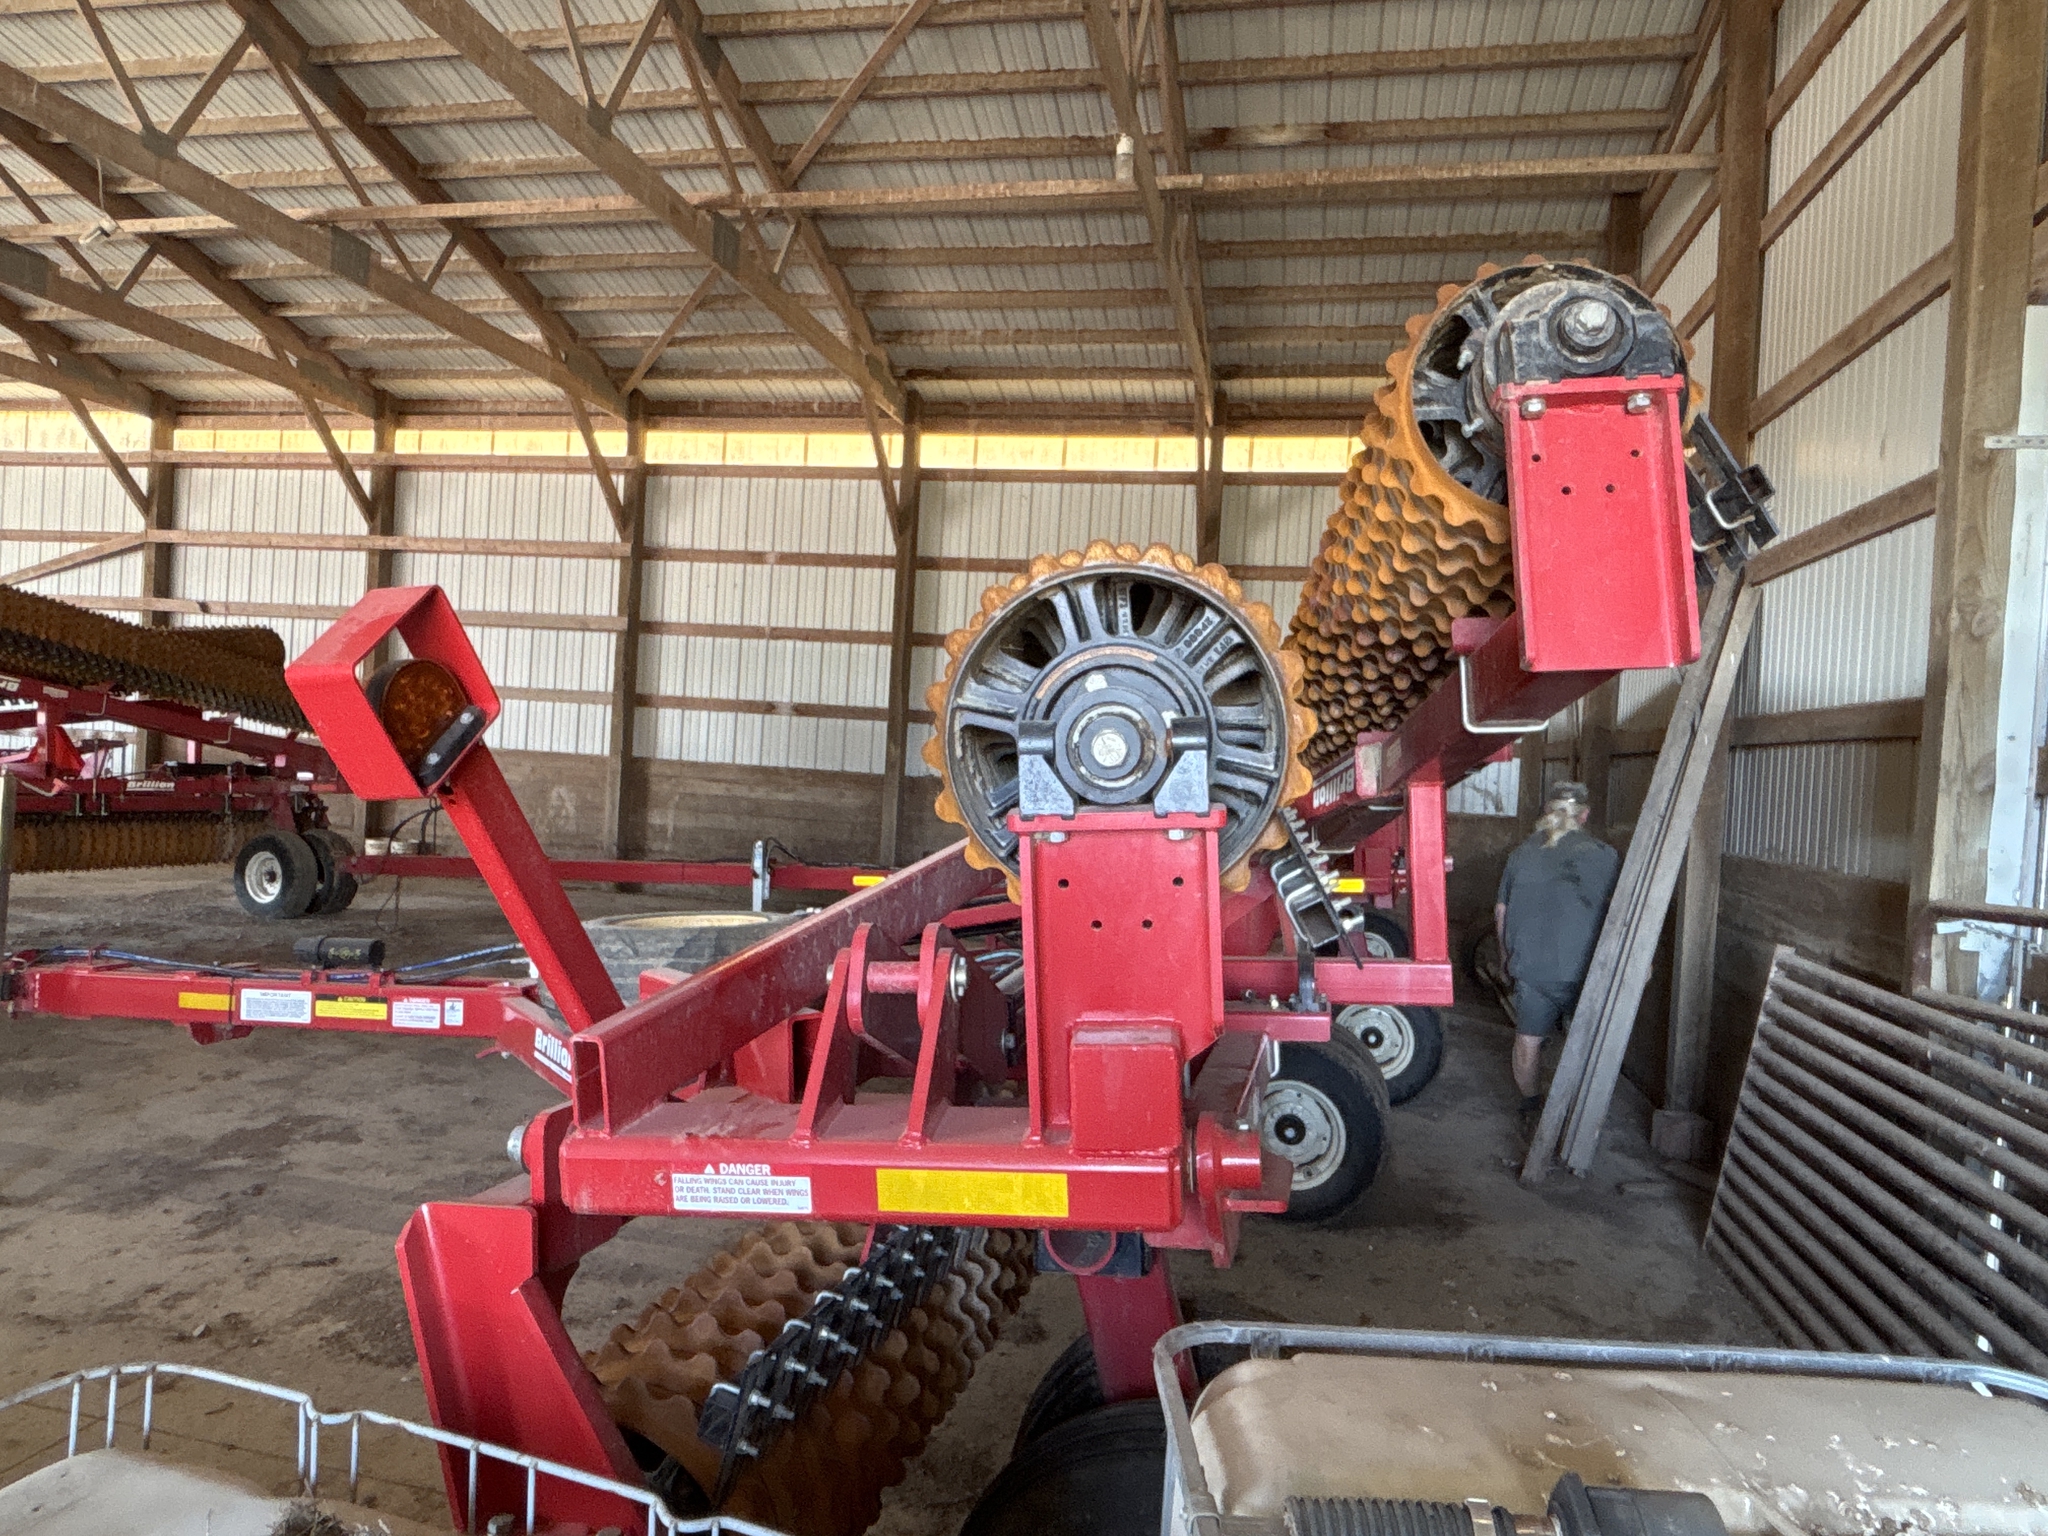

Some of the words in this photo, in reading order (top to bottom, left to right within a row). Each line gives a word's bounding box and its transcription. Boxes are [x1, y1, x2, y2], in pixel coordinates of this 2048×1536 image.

[1313, 767, 1355, 809] Brillion
[719, 1163, 771, 1175] DANGER
[674, 1176, 702, 1185] FALLING
[703, 1177, 727, 1185] WINGS
[728, 1177, 744, 1186] CAN
[745, 1178, 769, 1187] CAUSE
[770, 1179, 796, 1187] INJURY
[675, 1185, 684, 1193] OR
[712, 1186, 736, 1195] STAND
[737, 1187, 761, 1196] CLEAR
[762, 1188, 784, 1196] WHEN
[785, 1188, 809, 1197] WINGS
[675, 1195, 688, 1203] ARE
[690, 1195, 712, 1204] BEING
[713, 1196, 739, 1204] RAISED
[740, 1197, 751, 1205] OR
[752, 1197, 789, 1206] LOWERED.
